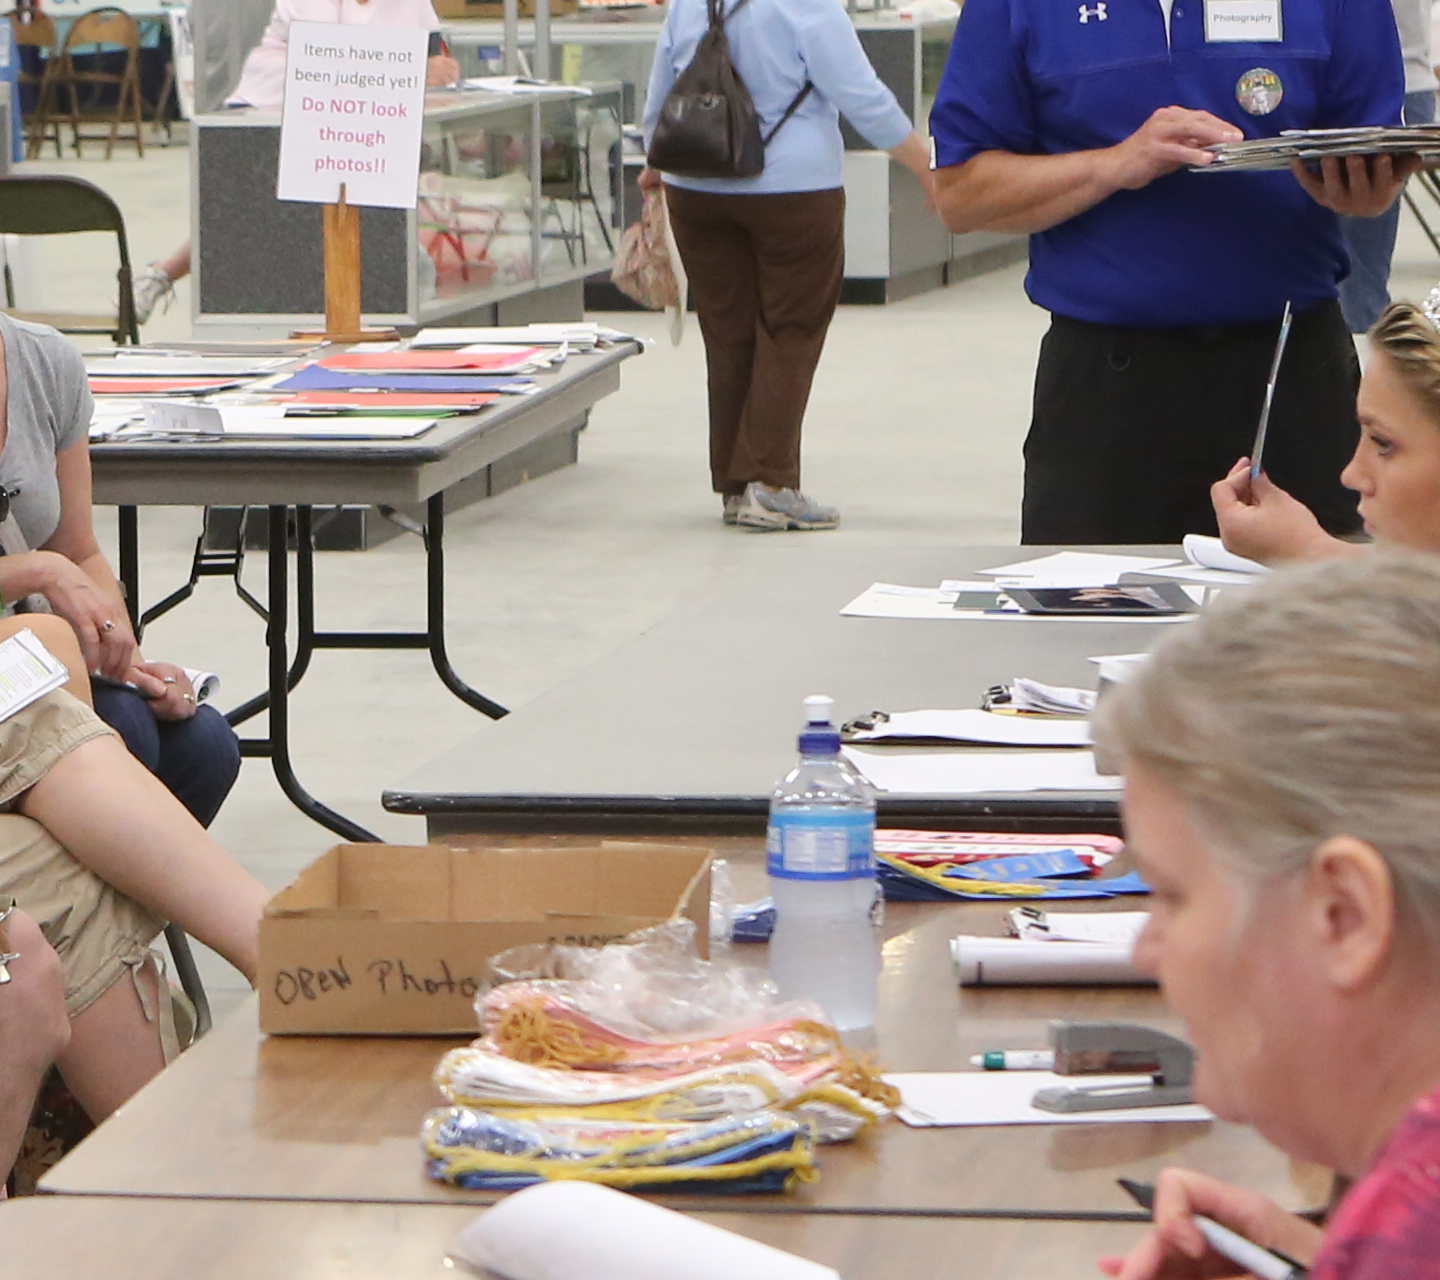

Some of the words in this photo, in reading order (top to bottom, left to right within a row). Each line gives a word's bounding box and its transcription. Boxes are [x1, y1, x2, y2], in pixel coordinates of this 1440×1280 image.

[1213, 12, 1273, 24] Photography
[304, 42, 345, 59] Items
[349, 45, 384, 62] have
[388, 48, 413, 64] not
[295, 67, 332, 83] been
[335, 70, 386, 87] judged
[389, 76, 418, 91] yet!
[302, 96, 325, 113] Do
[330, 99, 368, 115] NOT
[371, 102, 408, 119] look
[319, 126, 387, 148] through
[314, 154, 387, 175] photos!!
